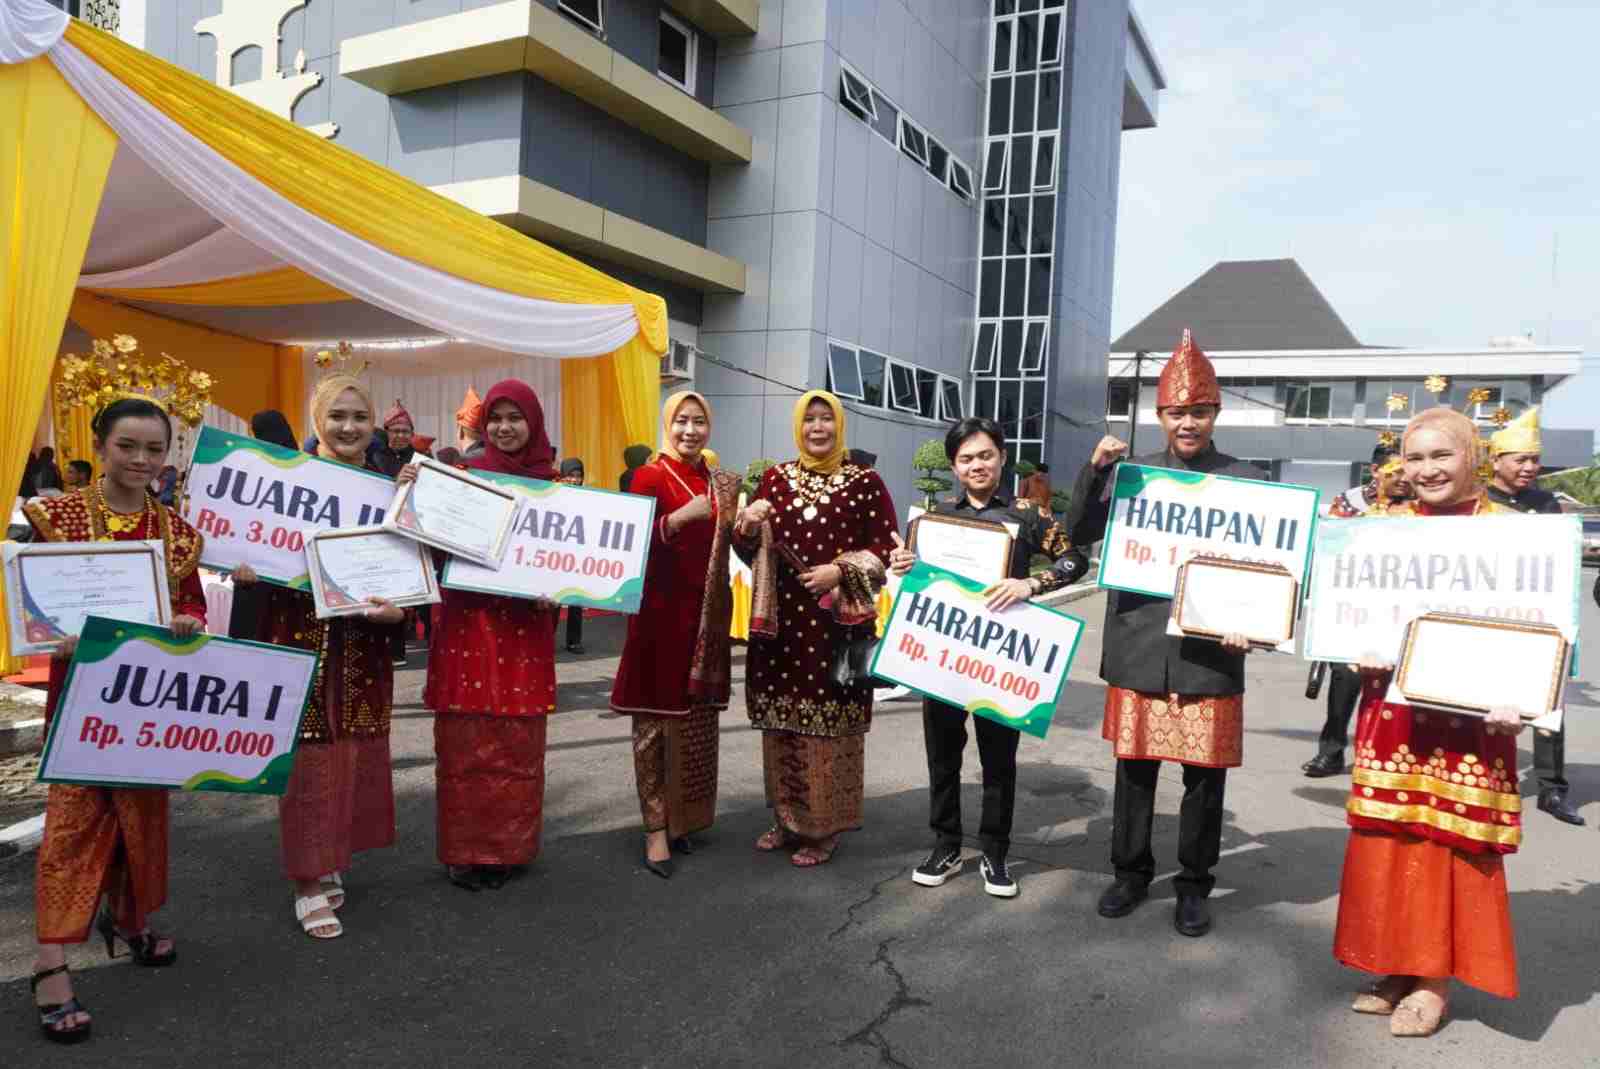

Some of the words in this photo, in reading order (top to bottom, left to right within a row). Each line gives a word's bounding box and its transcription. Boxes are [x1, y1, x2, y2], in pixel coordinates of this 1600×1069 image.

[206, 466, 340, 528] JUARA
[196, 508, 236, 539] Rp.
[511, 508, 586, 545] ARA
[598, 518, 636, 552] III
[1125, 496, 1266, 546] HARAPAN
[1275, 518, 1299, 551] II
[514, 546, 625, 580] 1.500.000
[1123, 539, 1157, 566] Rp.
[1332, 553, 1498, 592] HARAPAN
[1514, 552, 1555, 592] III
[905, 592, 1040, 667] HARAPAN
[1043, 643, 1059, 674] I
[1335, 601, 1368, 627] Rp
[898, 633, 928, 662] Rp.
[936, 648, 1041, 702] 1.000.000
[101, 664, 249, 718] JUARA
[264, 684, 283, 721] I
[79, 716, 124, 749] Rp.
[136, 721, 274, 758] 5.000.000
